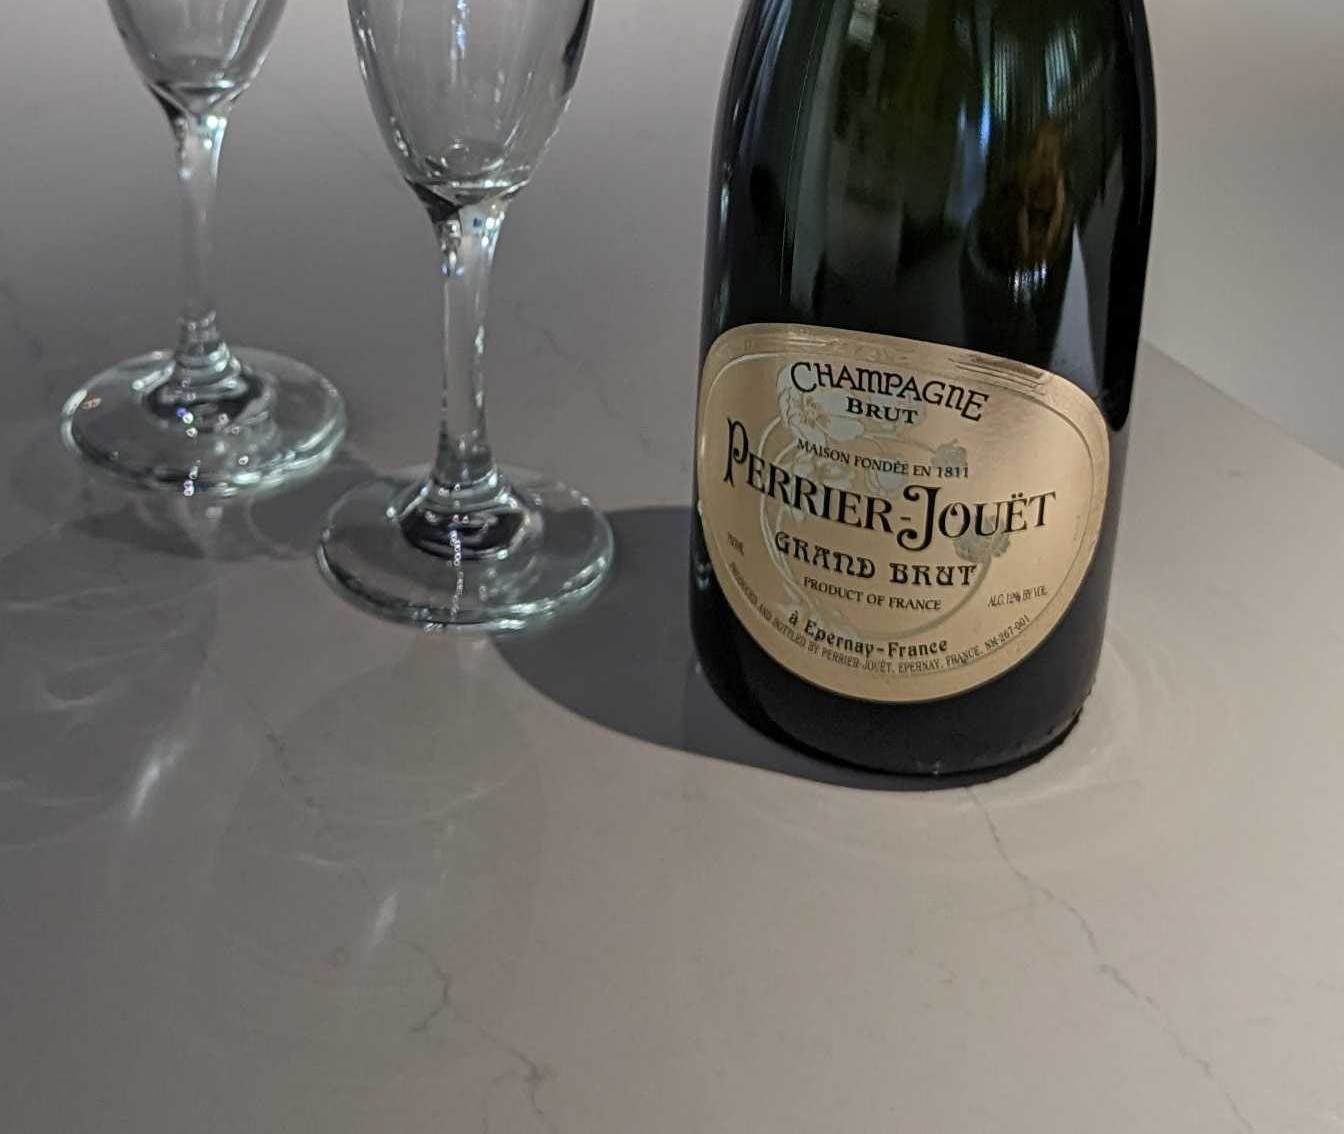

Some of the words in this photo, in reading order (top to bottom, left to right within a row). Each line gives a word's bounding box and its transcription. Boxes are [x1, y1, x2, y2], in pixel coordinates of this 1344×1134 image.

[790, 361, 990, 422] CHAMPAGNE
[844, 396, 919, 425] BRUT
[795, 437, 850, 465] MAISON
[854, 454, 909, 475] FONDÉE
[913, 464, 931, 477] EN
[937, 463, 969, 478] 1811
[723, 417, 1056, 552] PERRIER-JOUËT
[775, 531, 876, 579] GRAND
[889, 562, 977, 586] BRUT
[803, 576, 864, 603] PRODUCT
[866, 593, 885, 607] OF
[888, 596, 943, 610] FRANCE
[804, 618, 948, 659] Epernay-France
